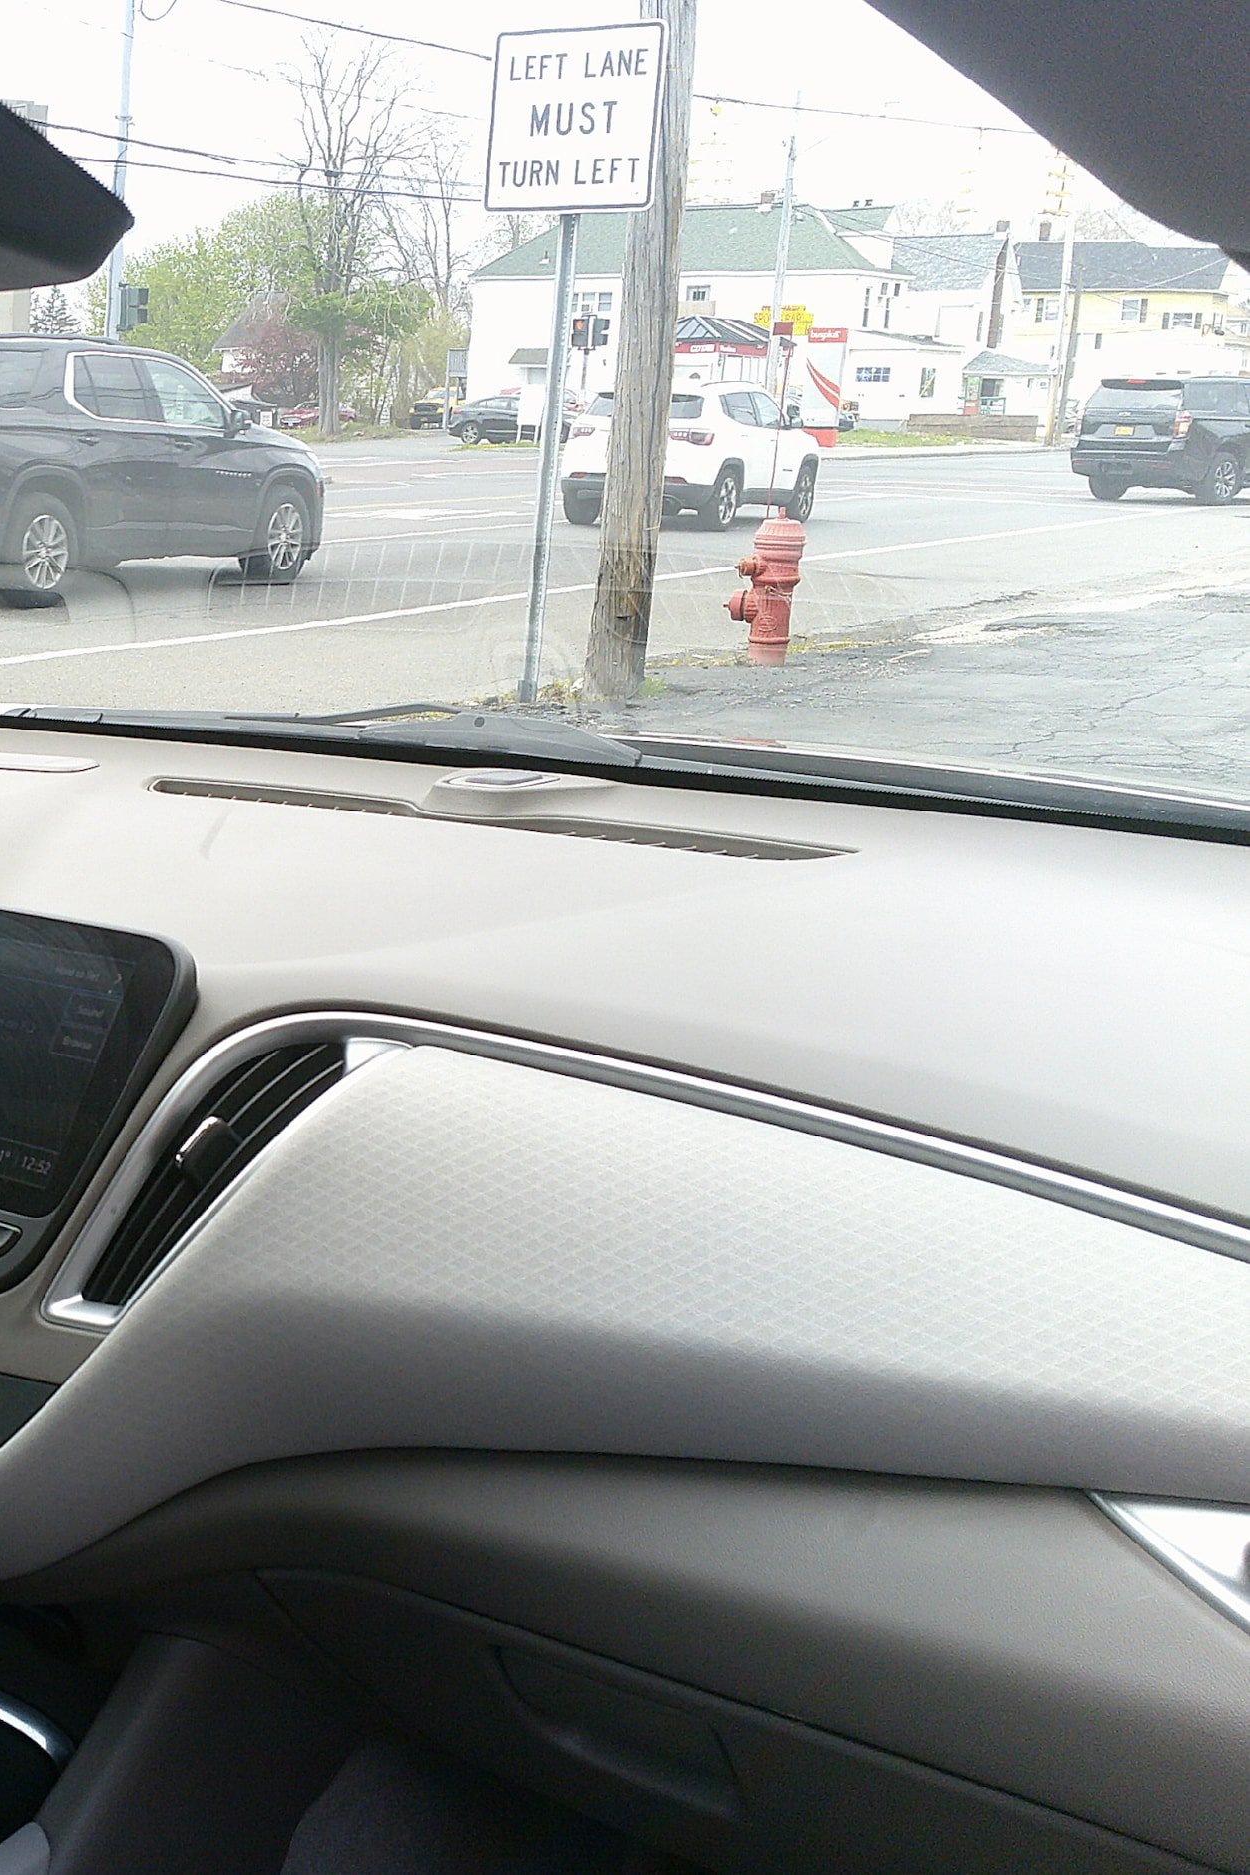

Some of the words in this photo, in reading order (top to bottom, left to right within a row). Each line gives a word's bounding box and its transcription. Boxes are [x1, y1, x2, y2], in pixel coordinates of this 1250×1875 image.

[510, 53, 568, 81] LEFT
[584, 49, 649, 78] LANE
[530, 101, 618, 137] MUST
[499, 160, 559, 187] TURN
[574, 158, 640, 184] LEFT
[21, 1156, 52, 1176] 12:52
